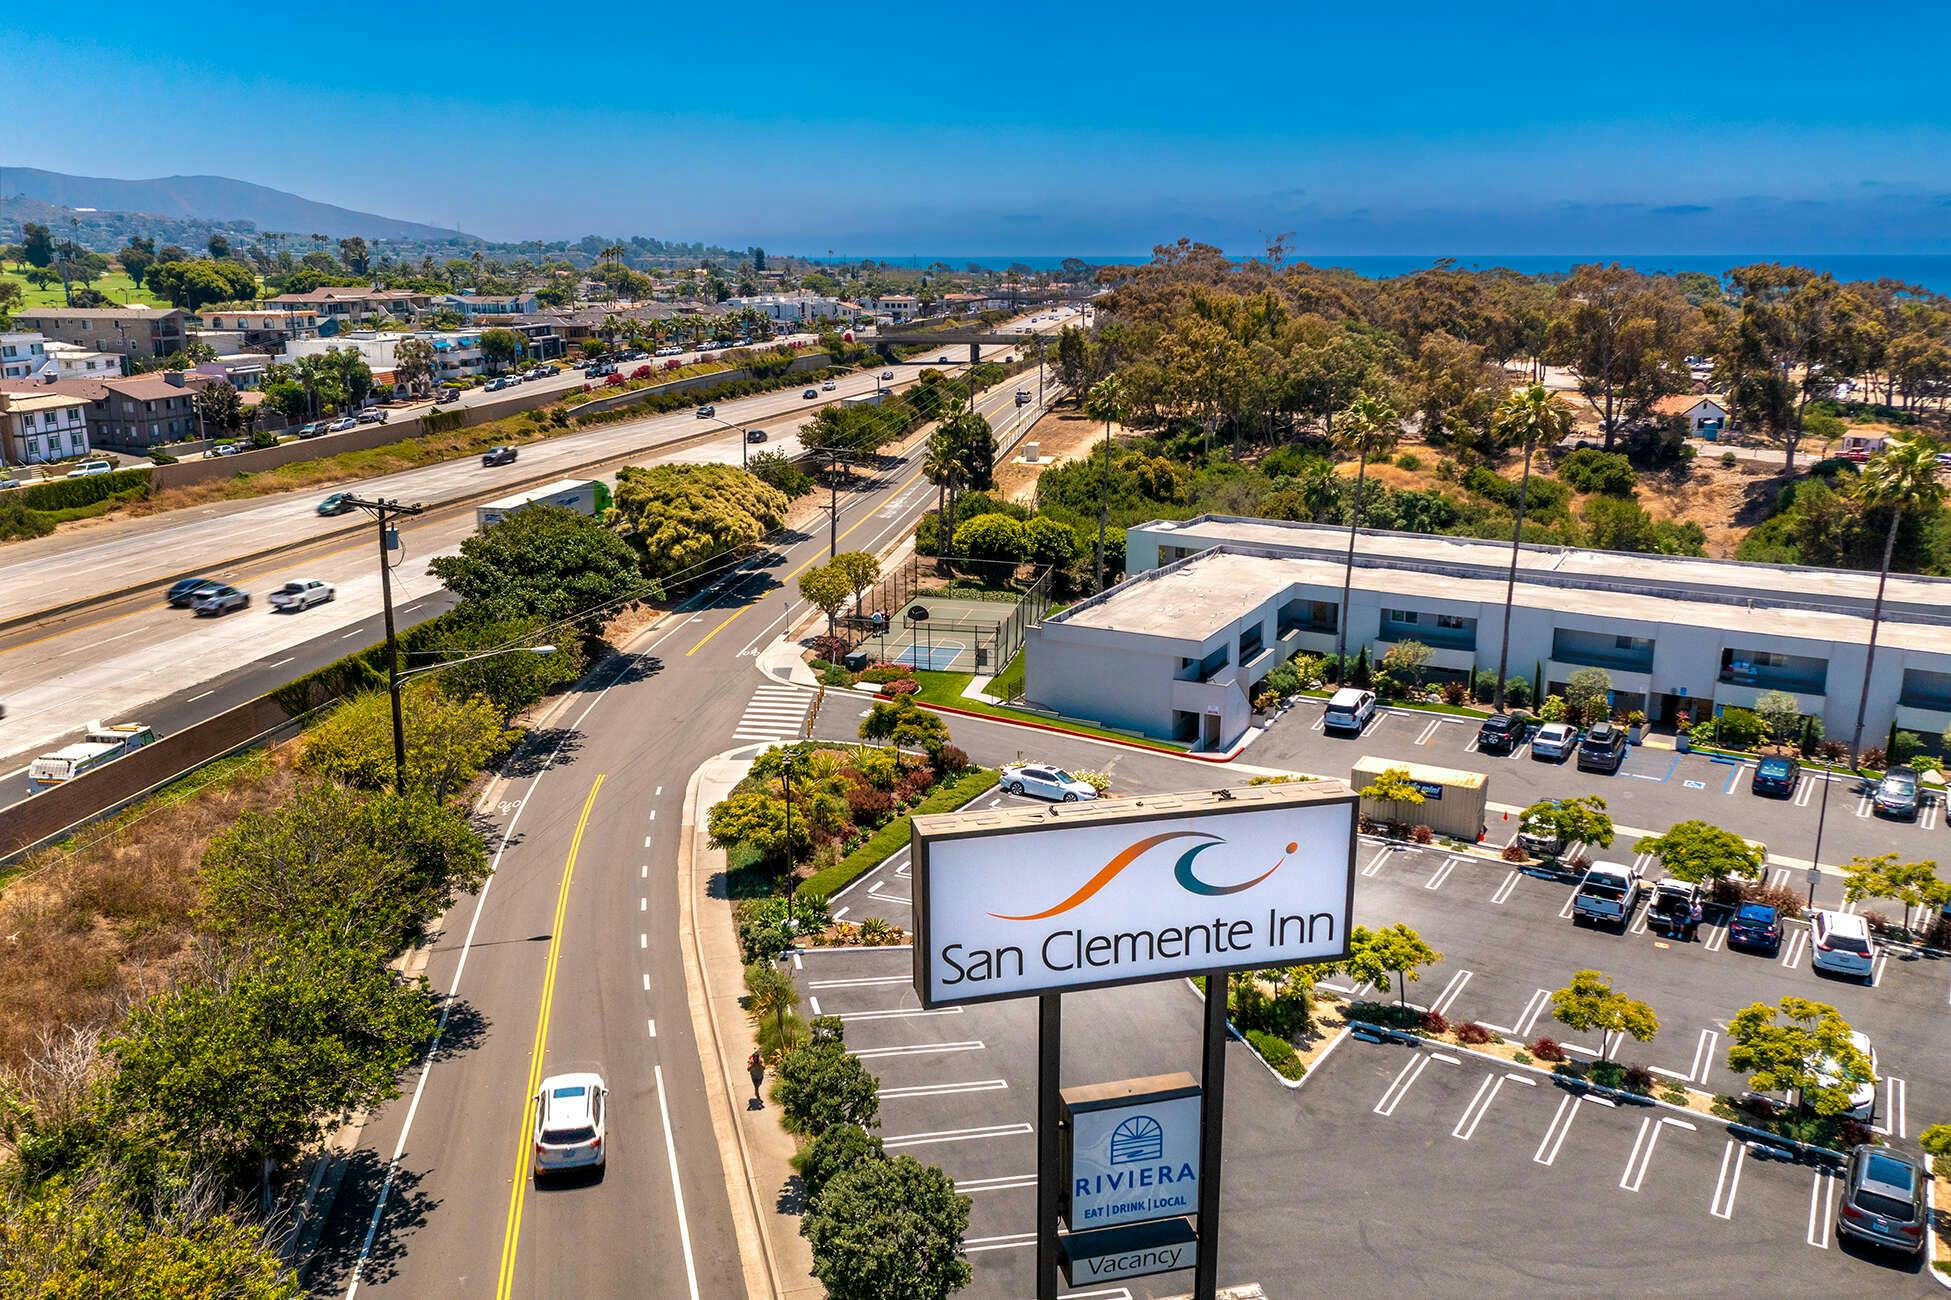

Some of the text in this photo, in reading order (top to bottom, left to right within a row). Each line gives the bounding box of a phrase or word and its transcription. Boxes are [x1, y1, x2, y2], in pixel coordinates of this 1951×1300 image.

[941, 908, 1334, 985] San Clemente Inn
[1075, 1162, 1196, 1197] RIVIERA
[1084, 1196, 1187, 1219] EAT DRINK LOCAL
[1088, 1247, 1182, 1275] Vacancy
